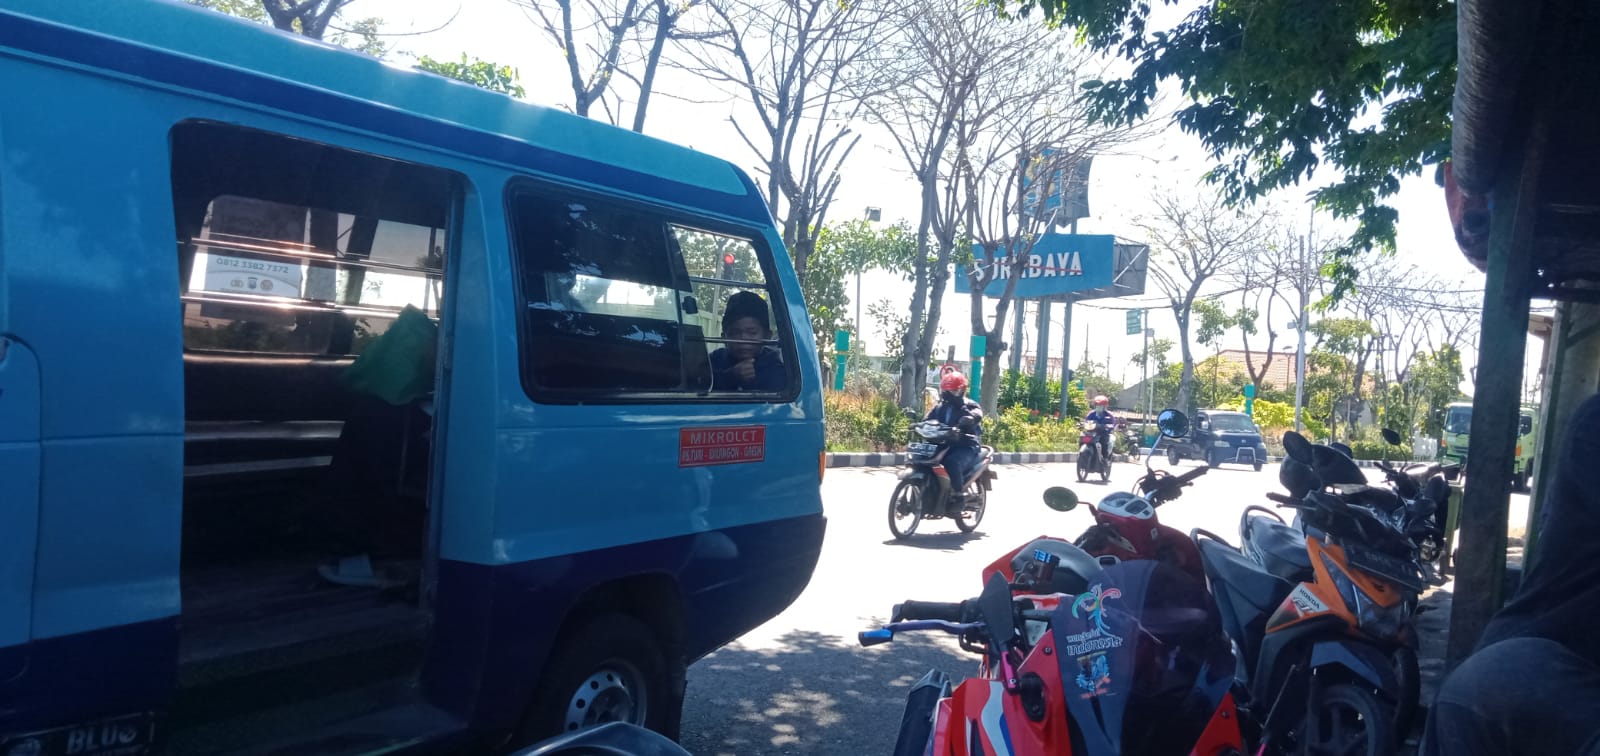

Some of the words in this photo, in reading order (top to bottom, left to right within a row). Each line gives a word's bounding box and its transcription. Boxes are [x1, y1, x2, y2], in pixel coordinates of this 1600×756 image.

[216, 257, 240, 267] 0812
[690, 430, 758, 445] MIKROLET
[1299, 588, 1320, 609] HONDA
